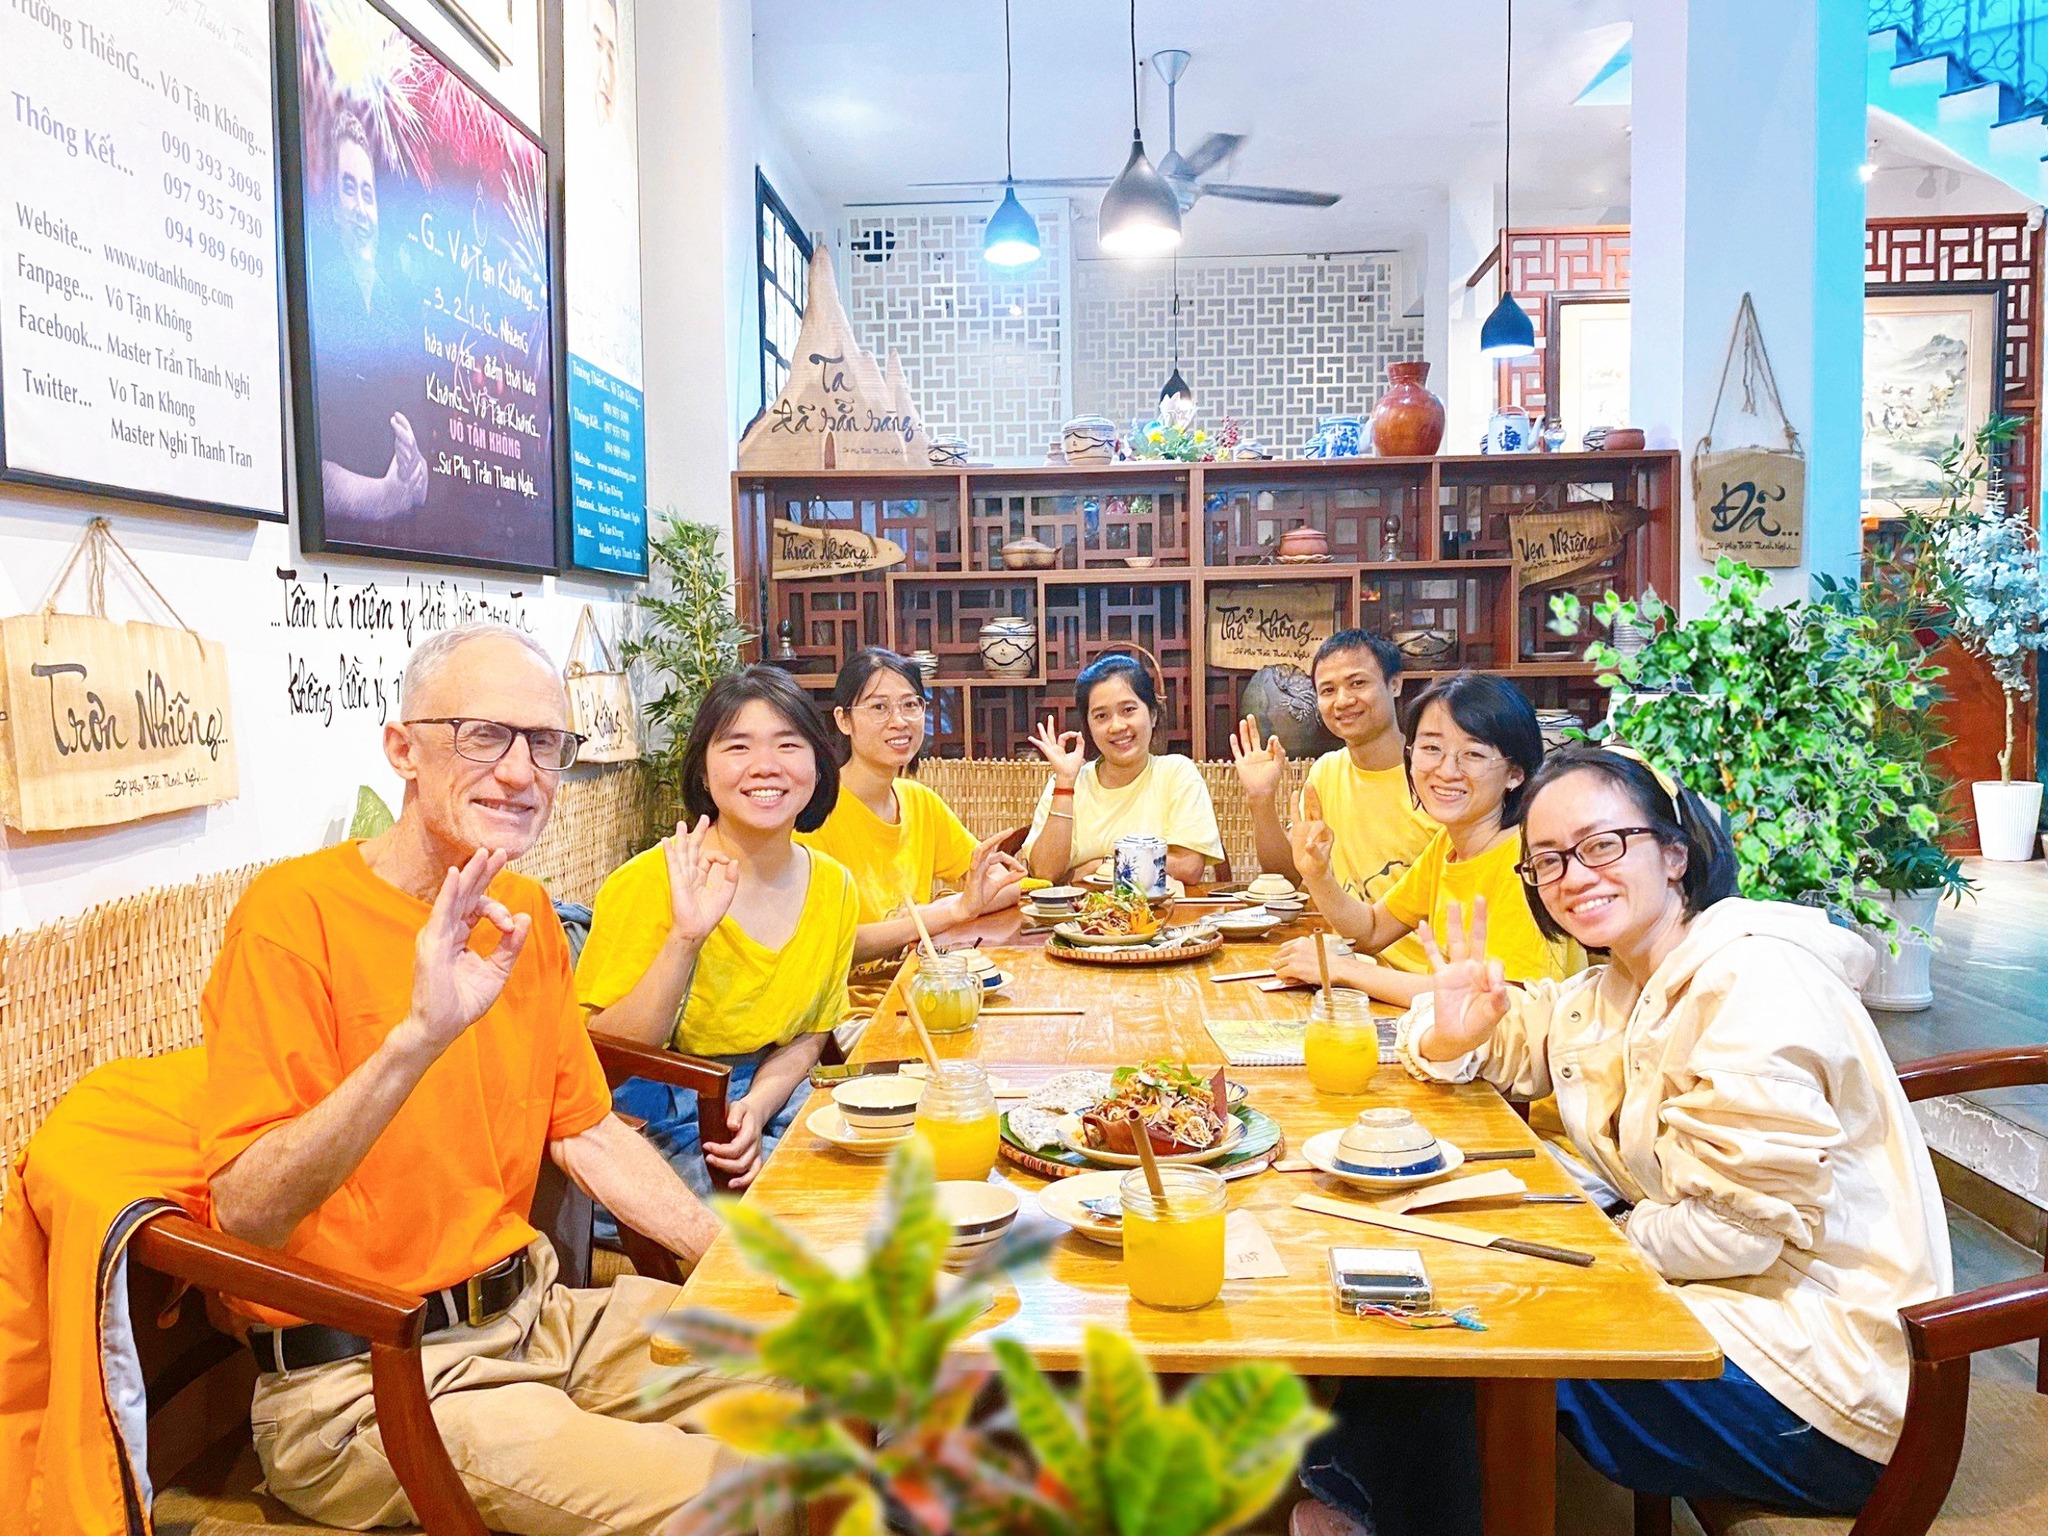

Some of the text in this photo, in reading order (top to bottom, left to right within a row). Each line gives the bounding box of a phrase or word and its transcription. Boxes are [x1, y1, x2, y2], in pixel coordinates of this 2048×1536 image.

[11, 91, 133, 176] Thông Kết...
[160, 70, 266, 155] Vô Tận Không...
[162, 131, 262, 202] 090 393 3098
[163, 172, 262, 239] 097 935 7930
[16, 201, 233, 309] Website... www.votankhong.com
[165, 216, 263, 279] 094 989 6909
[18, 252, 192, 342] Fanpage... Vô Tận Không
[19, 304, 250, 400] Facebook... Master Trần Thanh Nghị
[809, 353, 854, 393] Ta
[23, 368, 195, 426] Twitter... Vo Tan Khong
[111, 417, 252, 468] Master Nghi Thanh Tran
[449, 417, 521, 460] VÔ TẬN KHÔNG
[453, 455, 471, 485] Phụ
[493, 465, 517, 491] Thanh
[348, 582, 394, 639] niệm
[401, 575, 415, 648] ý
[1216, 606, 1254, 641] Thể
